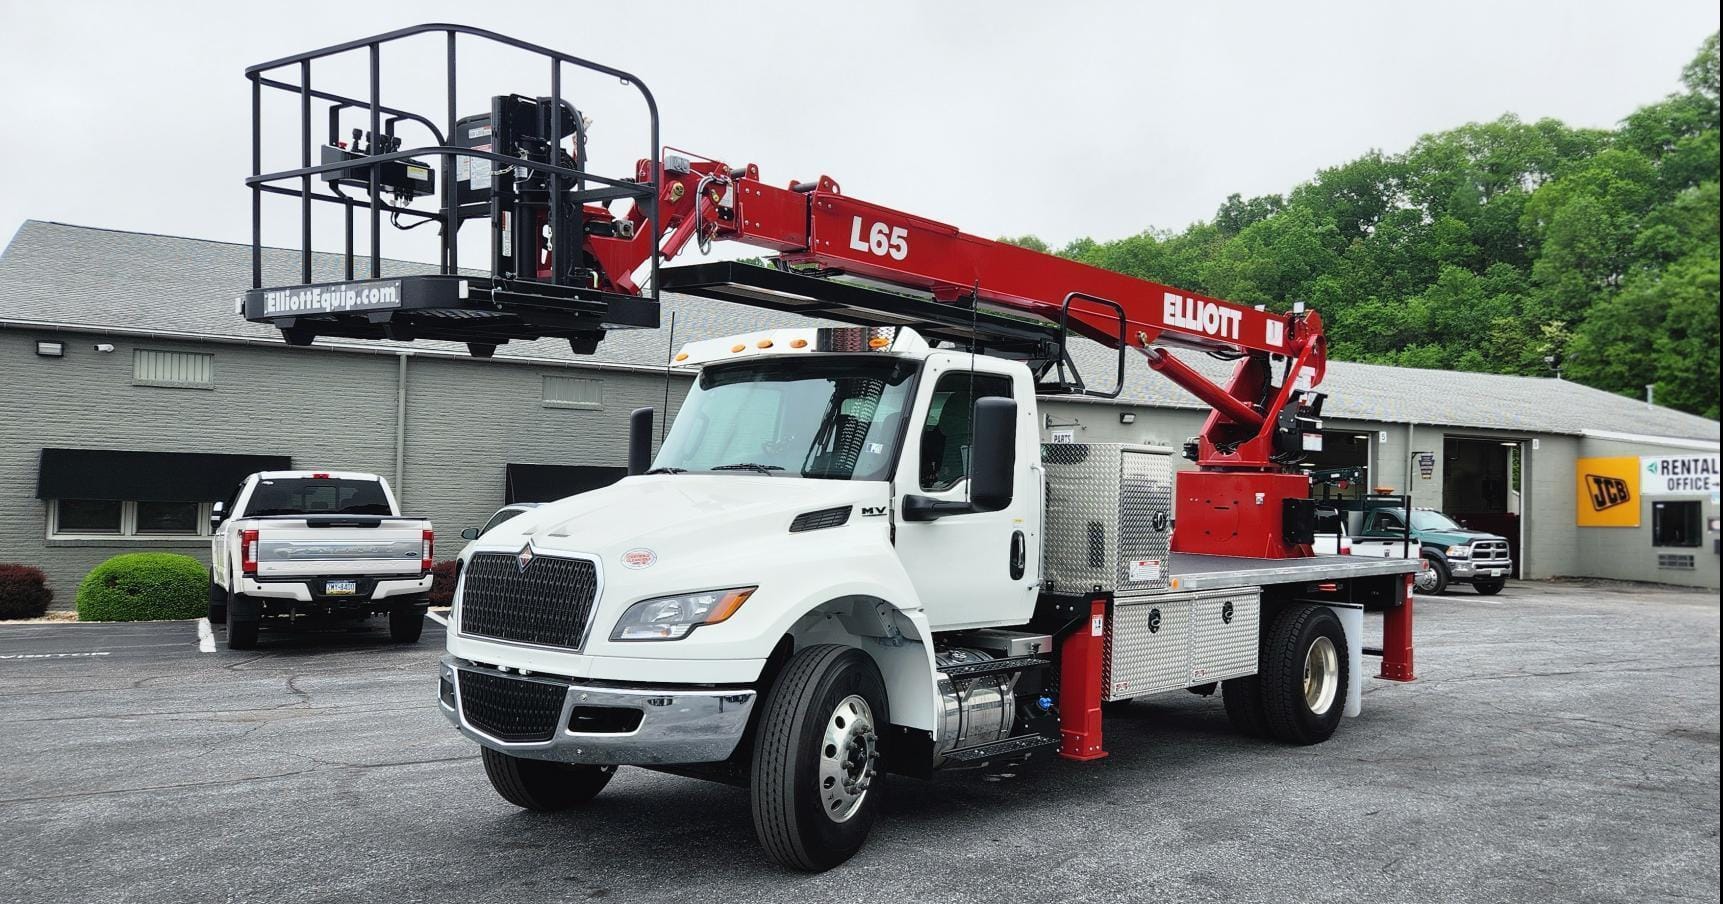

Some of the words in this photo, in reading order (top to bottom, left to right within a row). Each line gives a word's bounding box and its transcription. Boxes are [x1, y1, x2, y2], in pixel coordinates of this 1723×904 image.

[849, 215, 908, 261] L65
[267, 285, 396, 313] ElliottEquip.com
[1163, 292, 1242, 340] ELLIOTT
[1053, 434, 1072, 443] PARTS
[1661, 458, 1719, 476] RENTAL
[1592, 477, 1627, 508] JCB
[1667, 477, 1710, 491] OFFICE
[861, 506, 887, 515] MV
